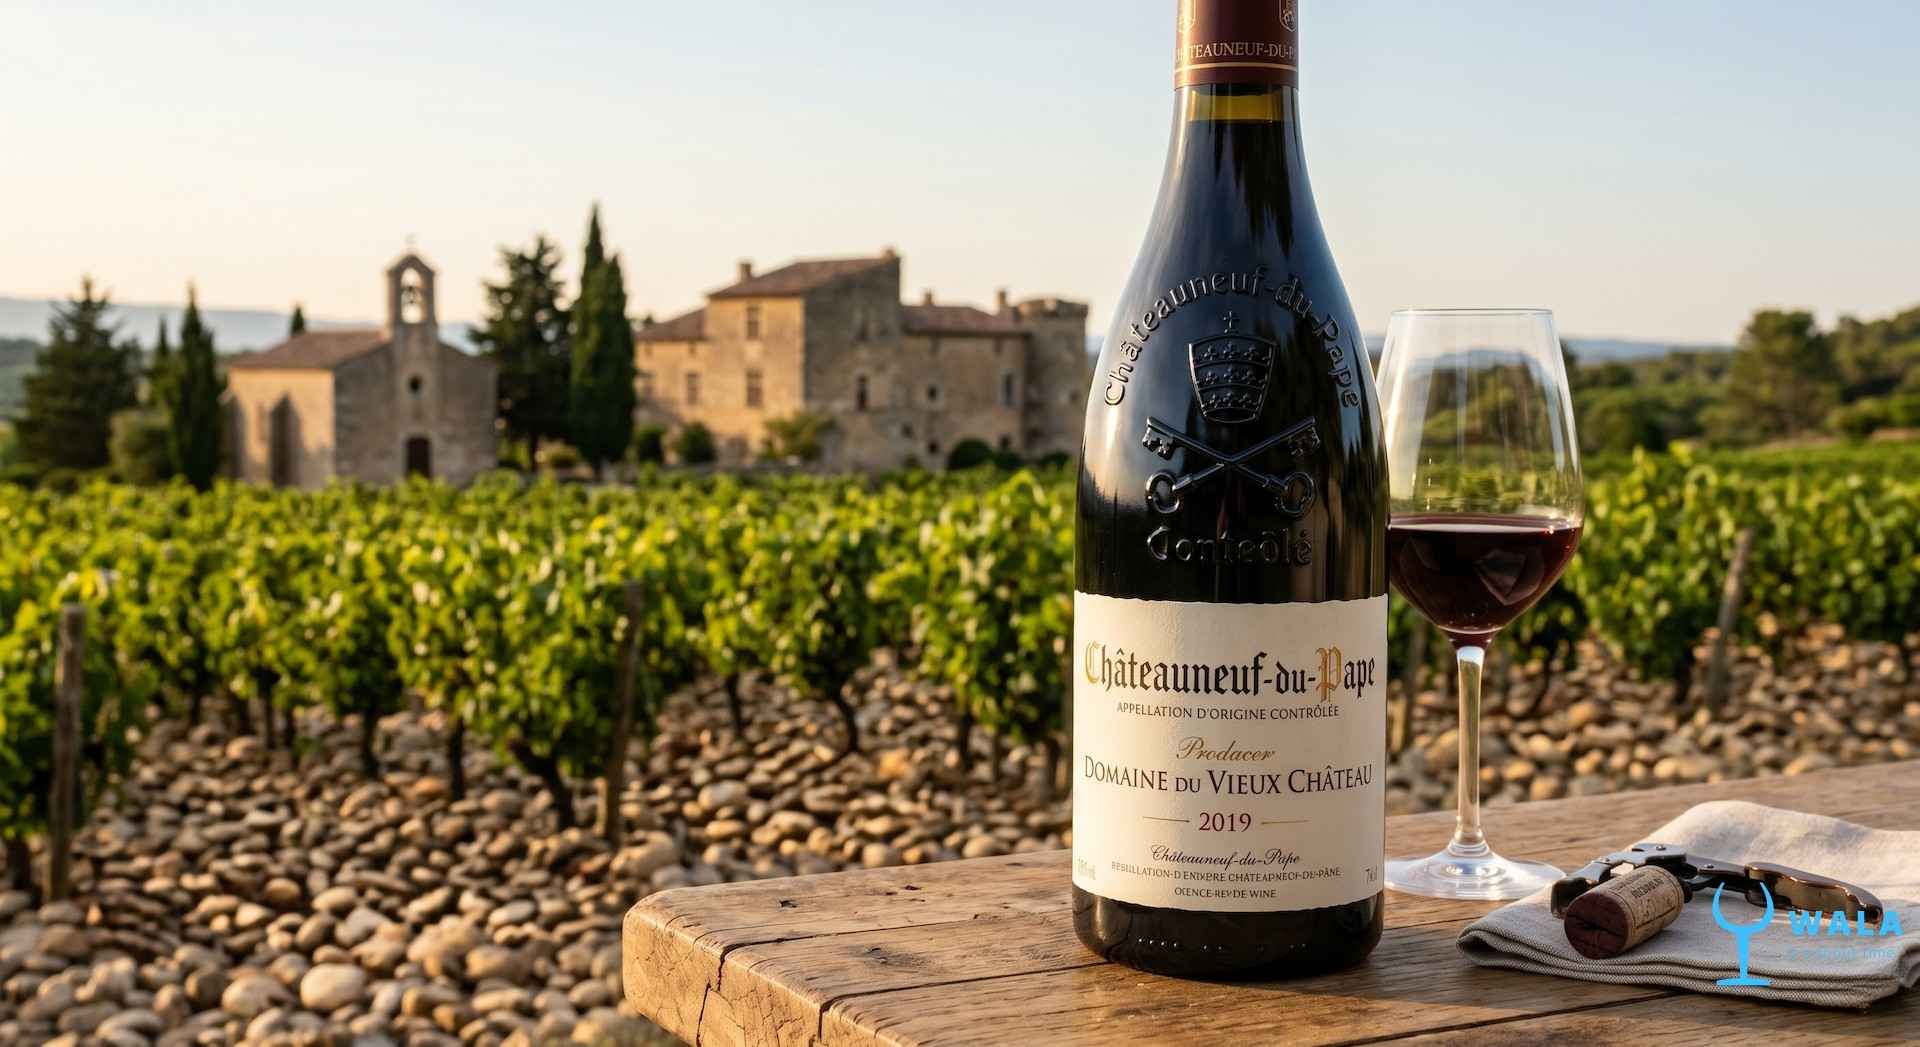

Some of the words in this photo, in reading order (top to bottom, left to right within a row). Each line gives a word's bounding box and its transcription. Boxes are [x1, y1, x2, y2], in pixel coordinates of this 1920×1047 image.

[1085, 640, 1376, 704] Châteauneuf-du-Pape
[1117, 702, 1193, 719] APPELLATION
[1197, 706, 1267, 721] D'ORIGINE
[1270, 703, 1340, 720] CONTRÔLÉE
[1206, 769, 1282, 795] VIEUX
[1288, 763, 1373, 793] CHÂTEAU
[1199, 812, 1252, 833] 2019
[1151, 844, 1300, 871] Châteauneuf-du-Pape
[1250, 889, 1277, 899] WINE
